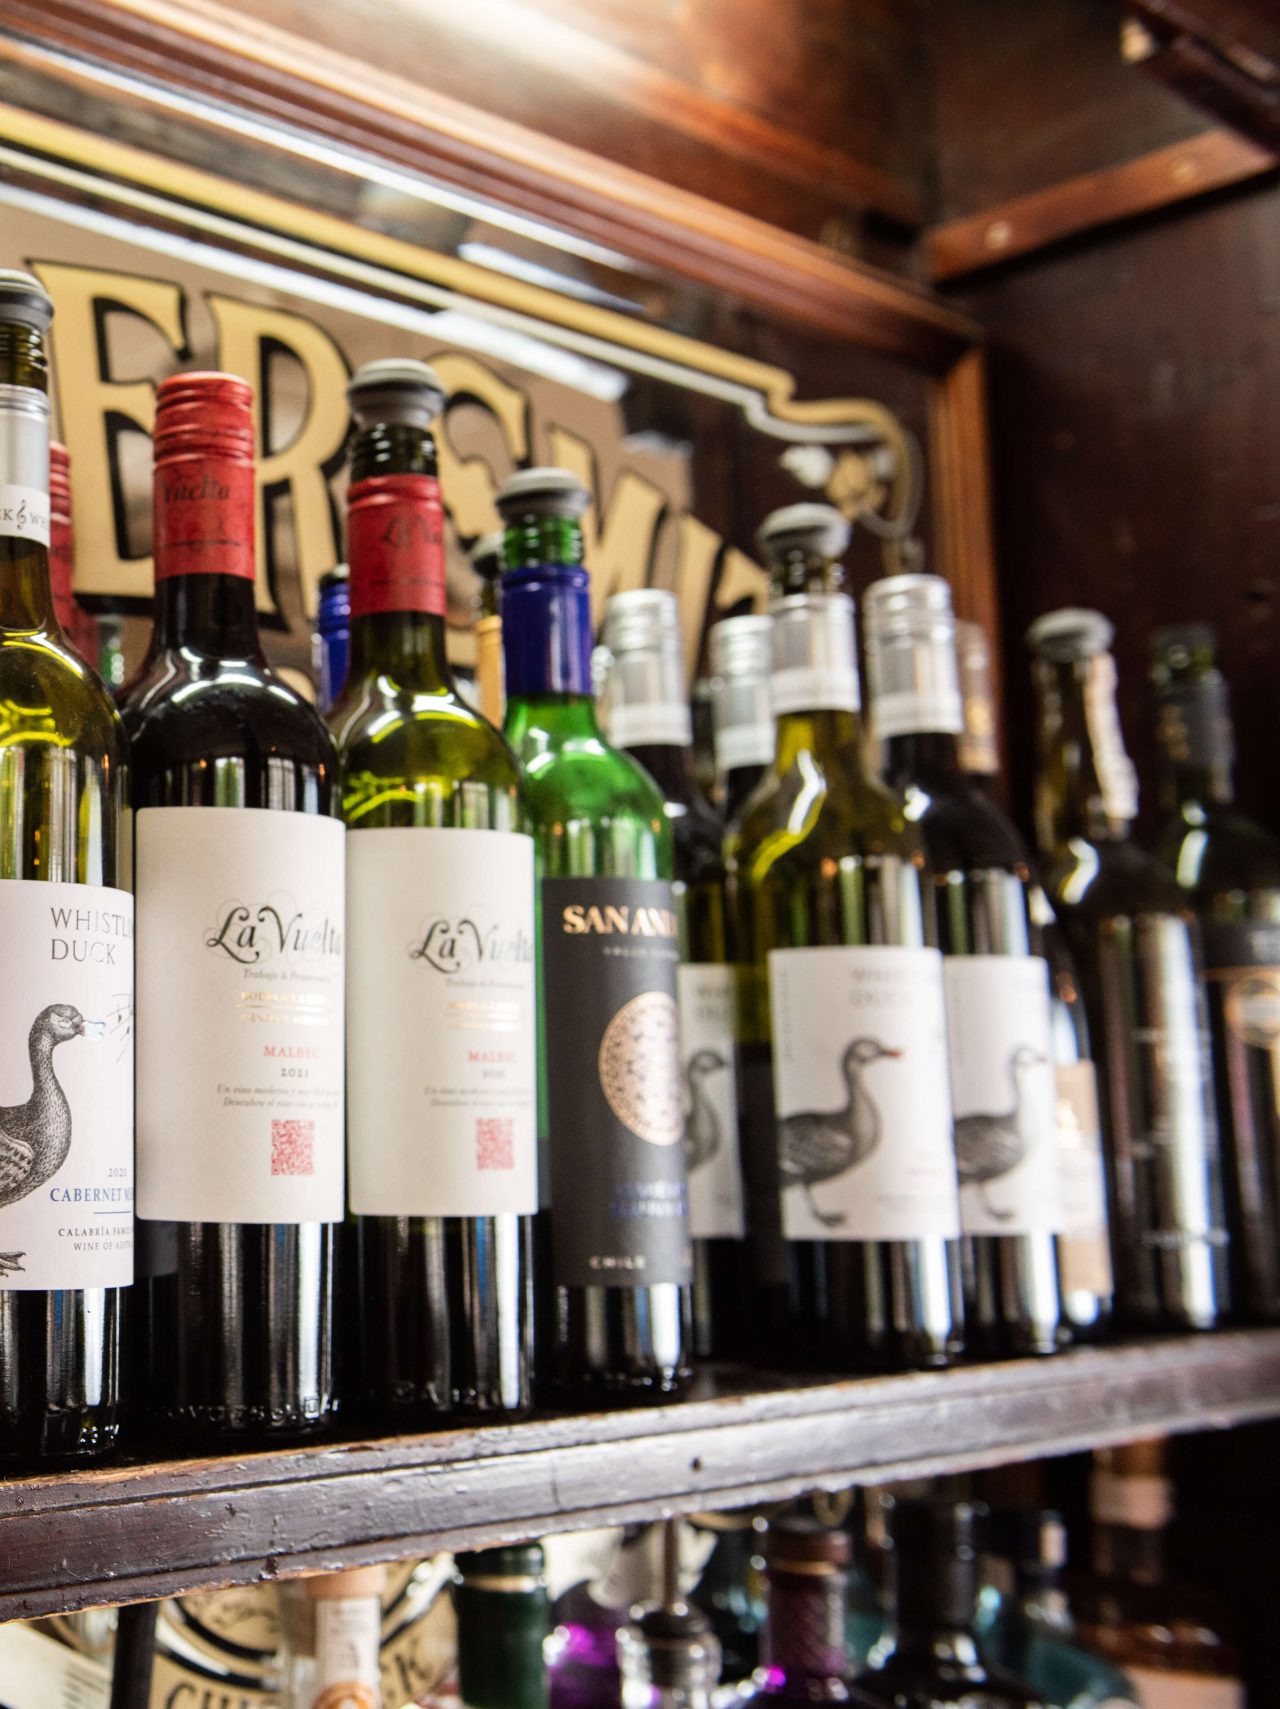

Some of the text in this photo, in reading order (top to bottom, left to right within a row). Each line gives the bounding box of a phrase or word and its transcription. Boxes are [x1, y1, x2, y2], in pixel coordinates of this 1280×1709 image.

[50, 906, 133, 938] WHISTL
[204, 904, 261, 965] La
[51, 938, 117, 966] DUCK
[408, 918, 461, 975] La
[49, 1187, 122, 1202] CABERNET
[73, 1241, 100, 1251] WINE
